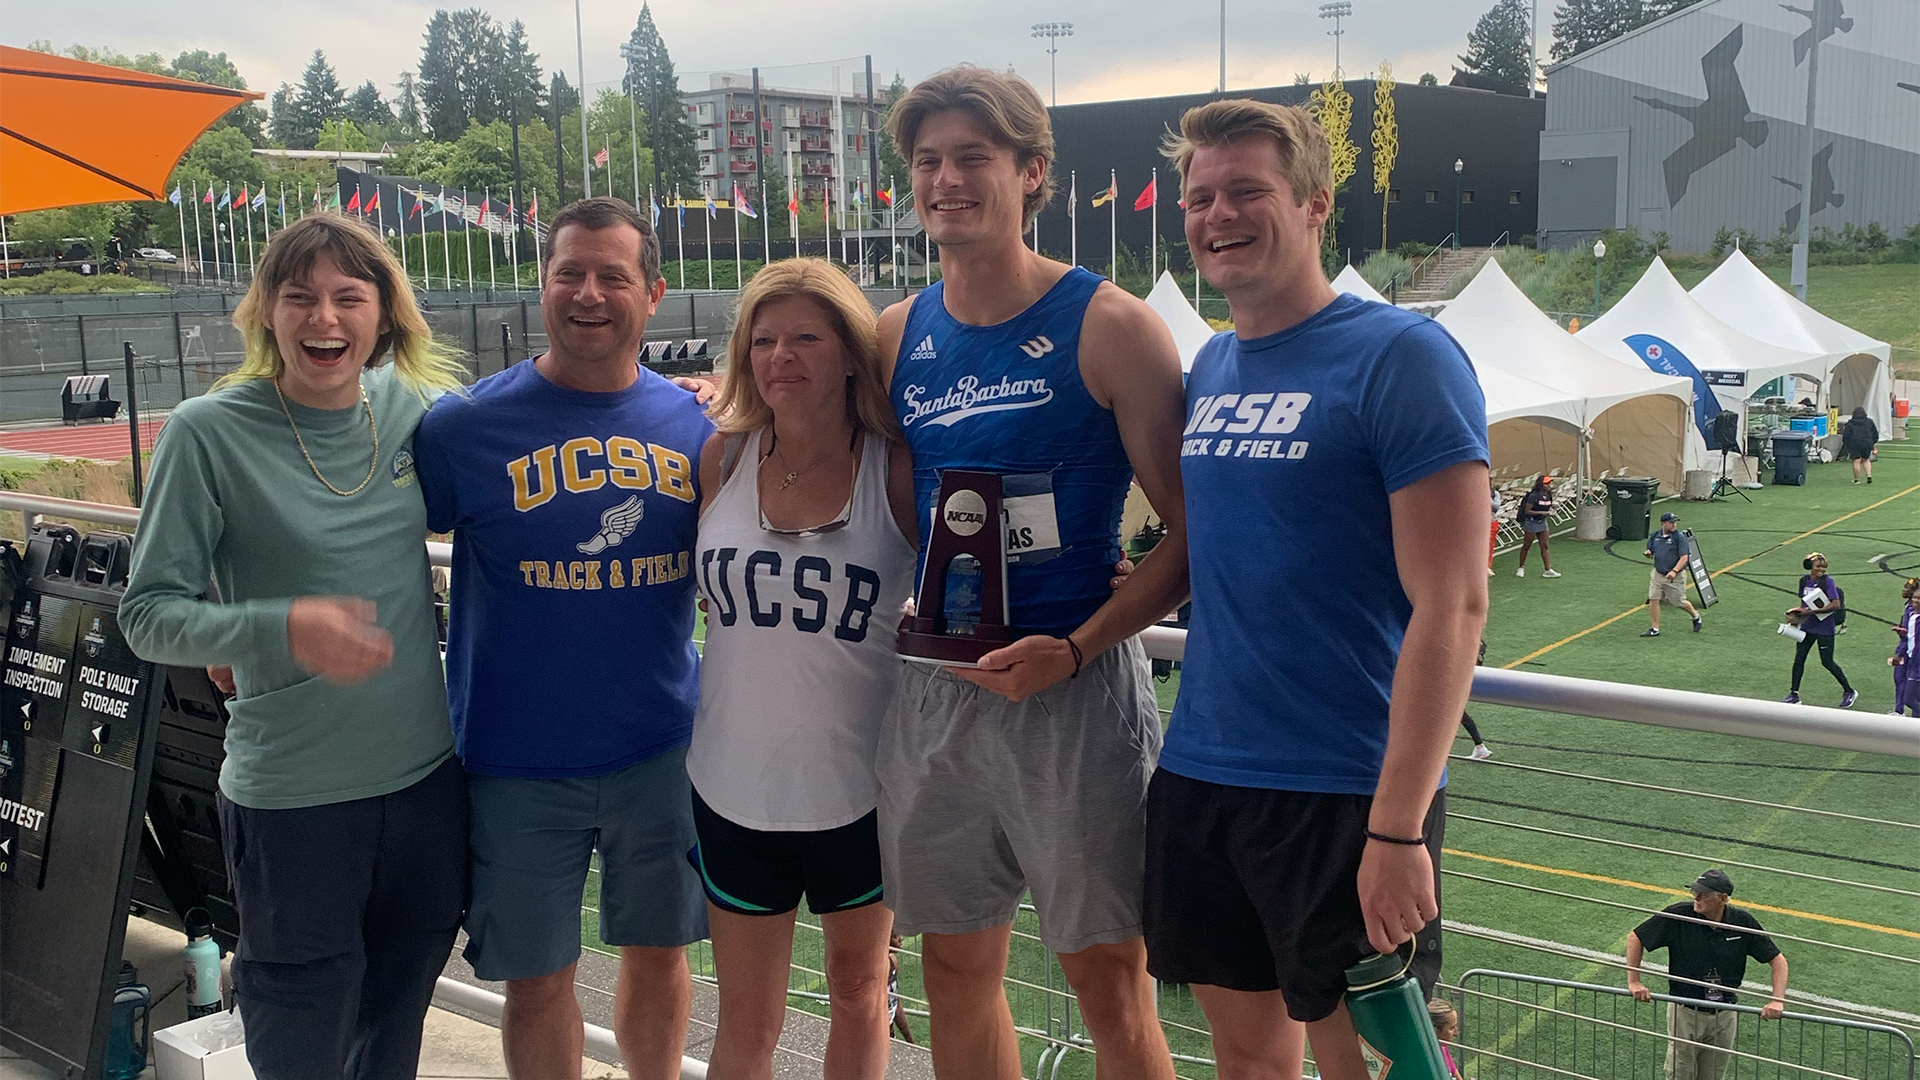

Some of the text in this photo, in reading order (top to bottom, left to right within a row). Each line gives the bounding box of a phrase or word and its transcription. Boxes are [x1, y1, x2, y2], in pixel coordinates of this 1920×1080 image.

[911, 350, 937, 360] adidas
[1183, 392, 1312, 436] UCSB
[1181, 438, 1213, 457] ACK
[1234, 440, 1309, 460] FIELD
[507, 435, 696, 513] UCSB
[946, 510, 984, 525] NCAA
[1008, 527, 1034, 550] AS
[519, 550, 690, 590] TRACK & FIELD
[701, 547, 881, 643] UCSB
[8, 646, 66, 675] IMPLEMENT
[4, 668, 64, 699] INSPECTION
[79, 666, 139, 696] POLE VAULT
[81, 690, 130, 719] STORAGE
[0, 797, 45, 831] OTEST
